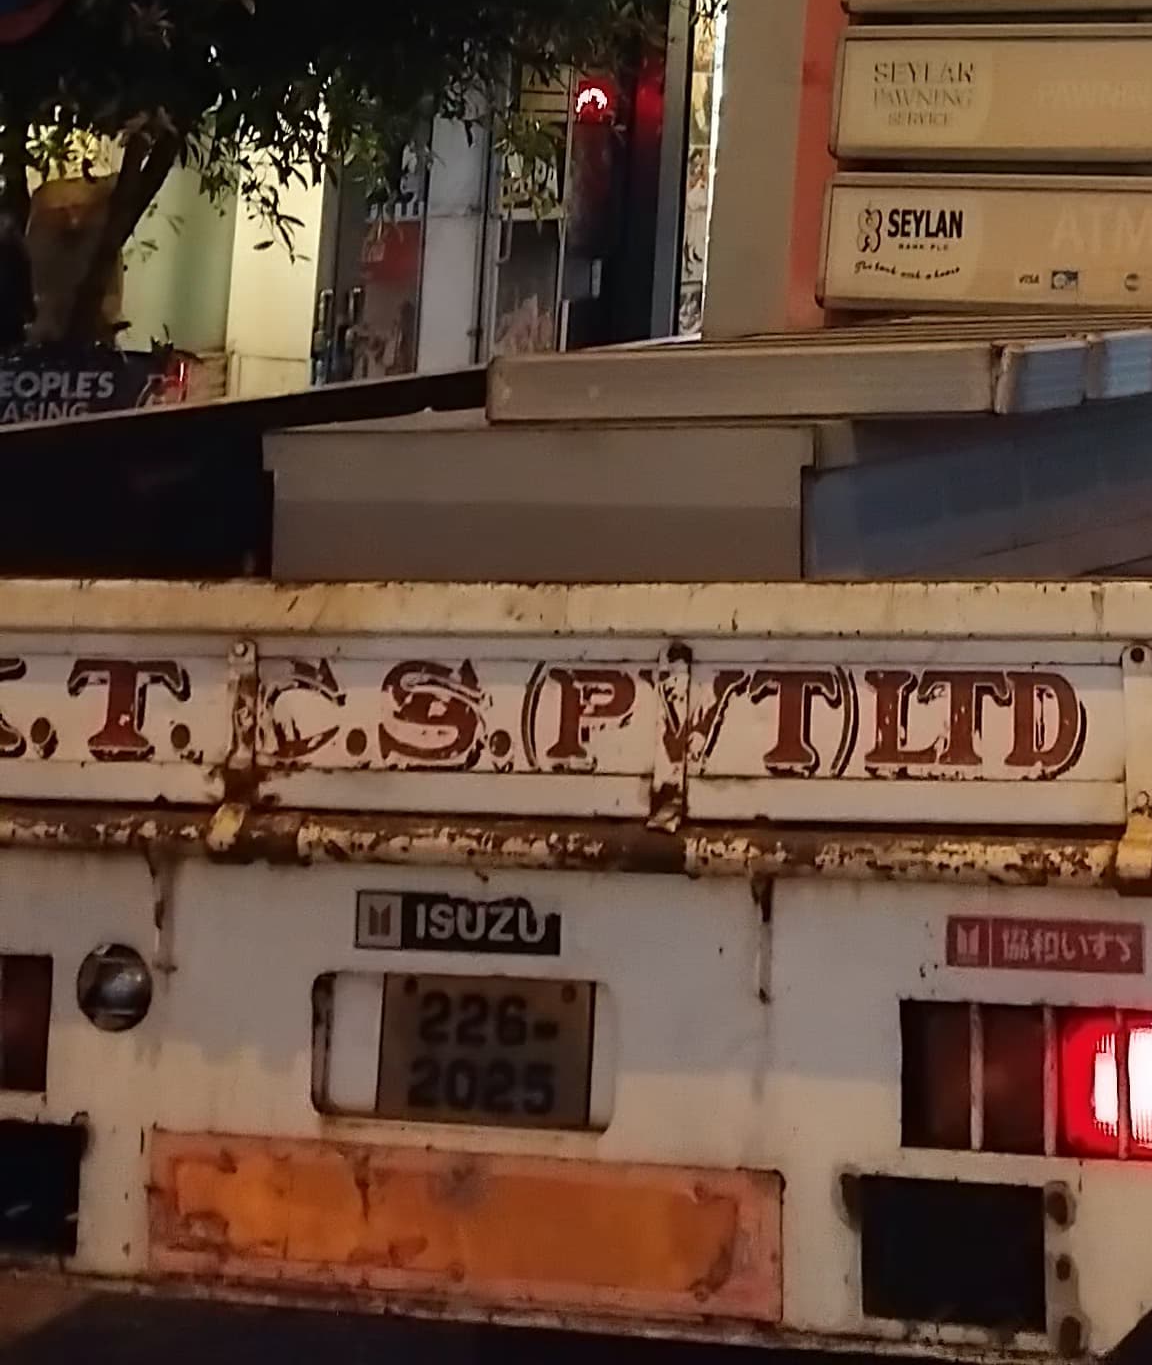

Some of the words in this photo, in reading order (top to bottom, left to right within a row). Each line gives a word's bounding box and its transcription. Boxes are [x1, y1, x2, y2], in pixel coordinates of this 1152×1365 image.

[886, 207, 964, 239] SEYLAN
[414, 902, 548, 944] ISUZU
[419, 990, 560, 1048] 226-
[408, 1058, 556, 1114] 2025
